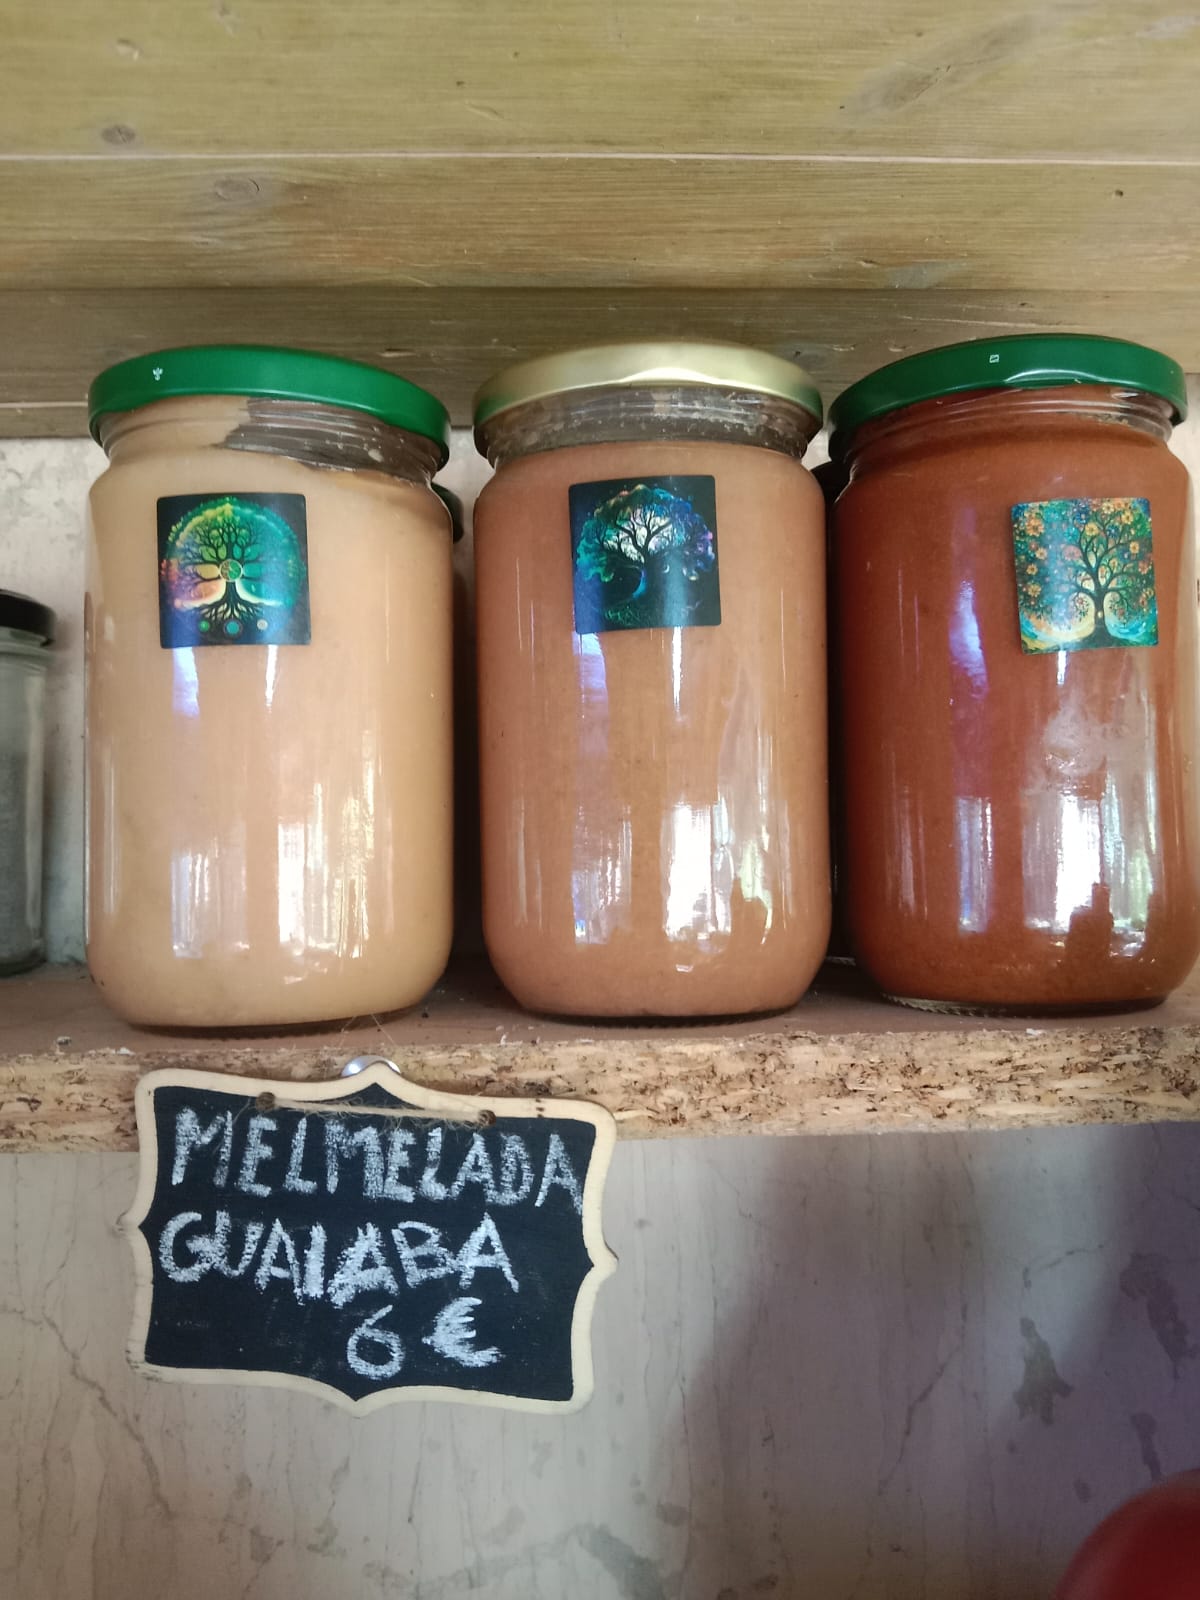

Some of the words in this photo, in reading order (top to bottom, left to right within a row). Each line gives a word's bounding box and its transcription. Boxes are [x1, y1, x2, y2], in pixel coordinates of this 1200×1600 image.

[171, 1106, 584, 1215] MELMELADA
[158, 1209, 519, 1308] GUAIABA
[346, 1304, 405, 1380] 6
[422, 1296, 501, 1369] €
